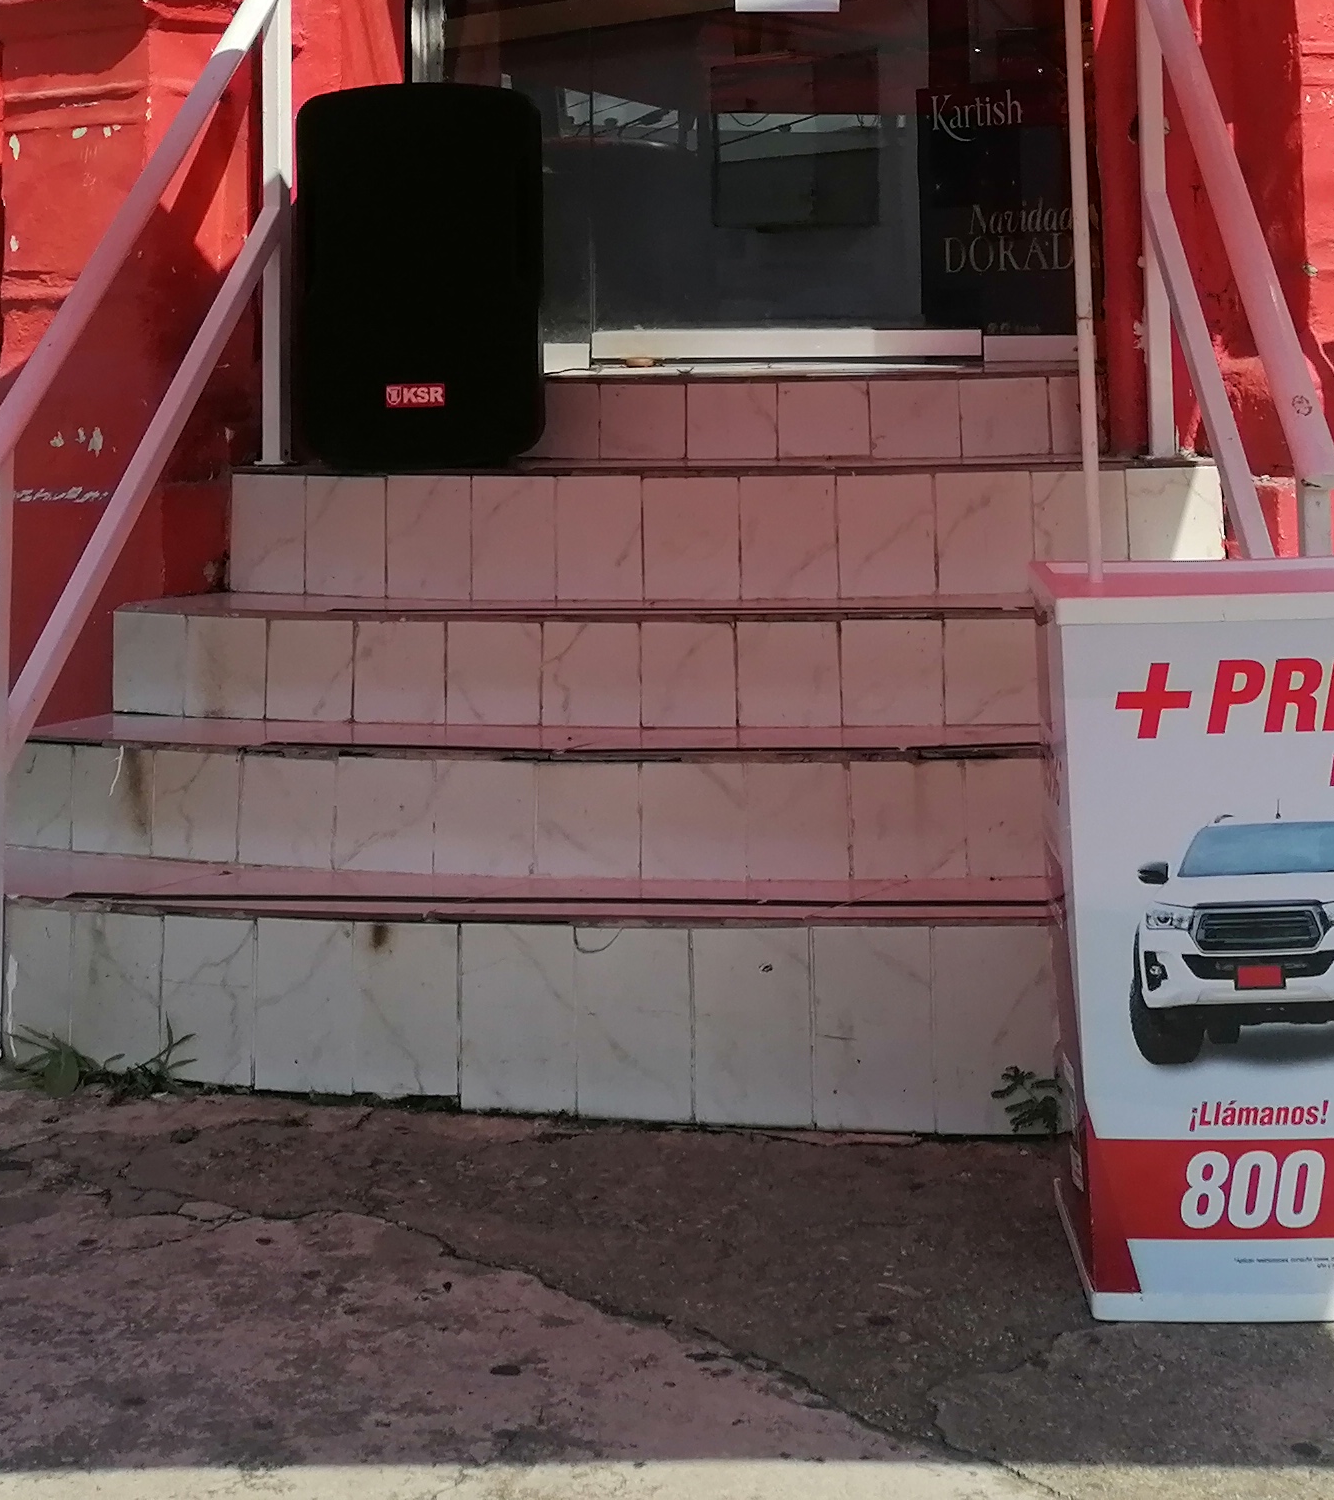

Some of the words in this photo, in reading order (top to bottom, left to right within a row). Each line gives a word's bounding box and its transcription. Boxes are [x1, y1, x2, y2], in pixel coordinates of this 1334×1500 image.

[931, 89, 1023, 142] Kartish
[944, 232, 1075, 273] DORAD
[403, 386, 444, 403] KSR
[1188, 1099, 1330, 1133] ¡Llámanos!
[1180, 1149, 1326, 1230] 800
